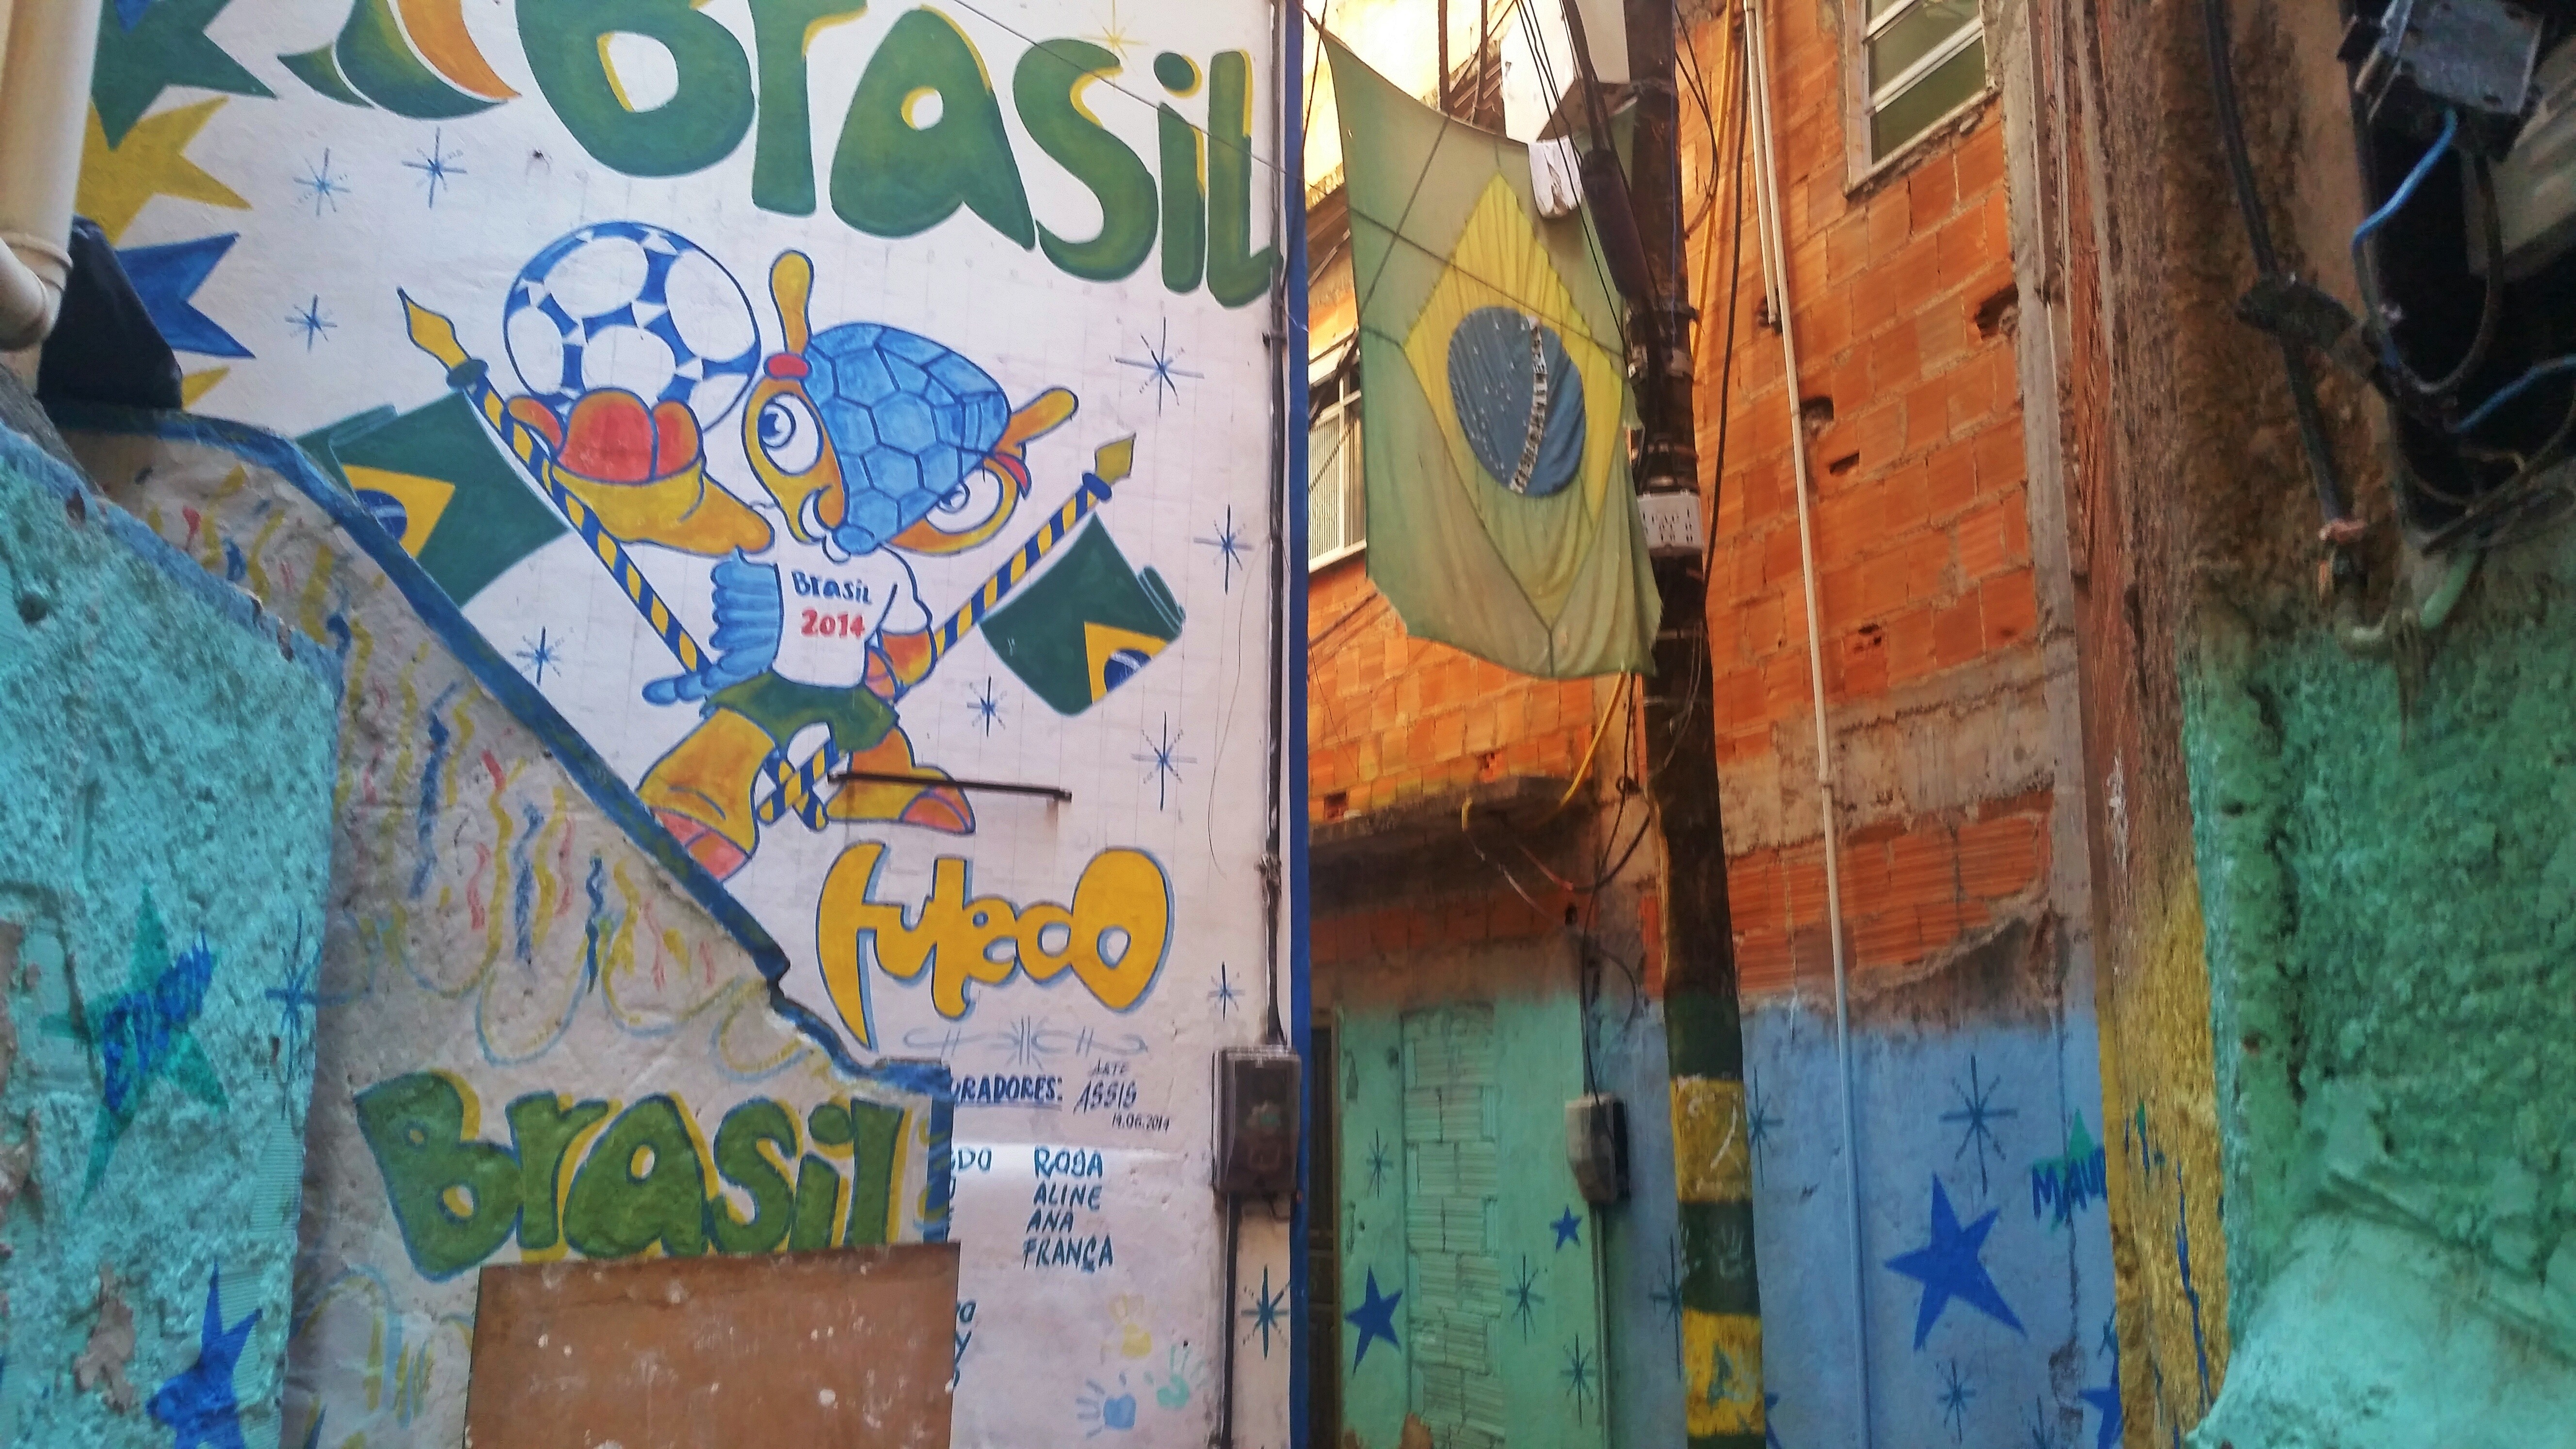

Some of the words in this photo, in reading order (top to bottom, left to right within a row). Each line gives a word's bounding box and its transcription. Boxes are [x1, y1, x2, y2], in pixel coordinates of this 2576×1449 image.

[790, 568, 872, 606] Brasil
[801, 607, 865, 638] 2014
[951, 1146, 992, 1173] DO
[352, 1069, 913, 1284] Brasil
[1033, 1180, 1102, 1211] ALINE
[1026, 1208, 1074, 1234] ANA
